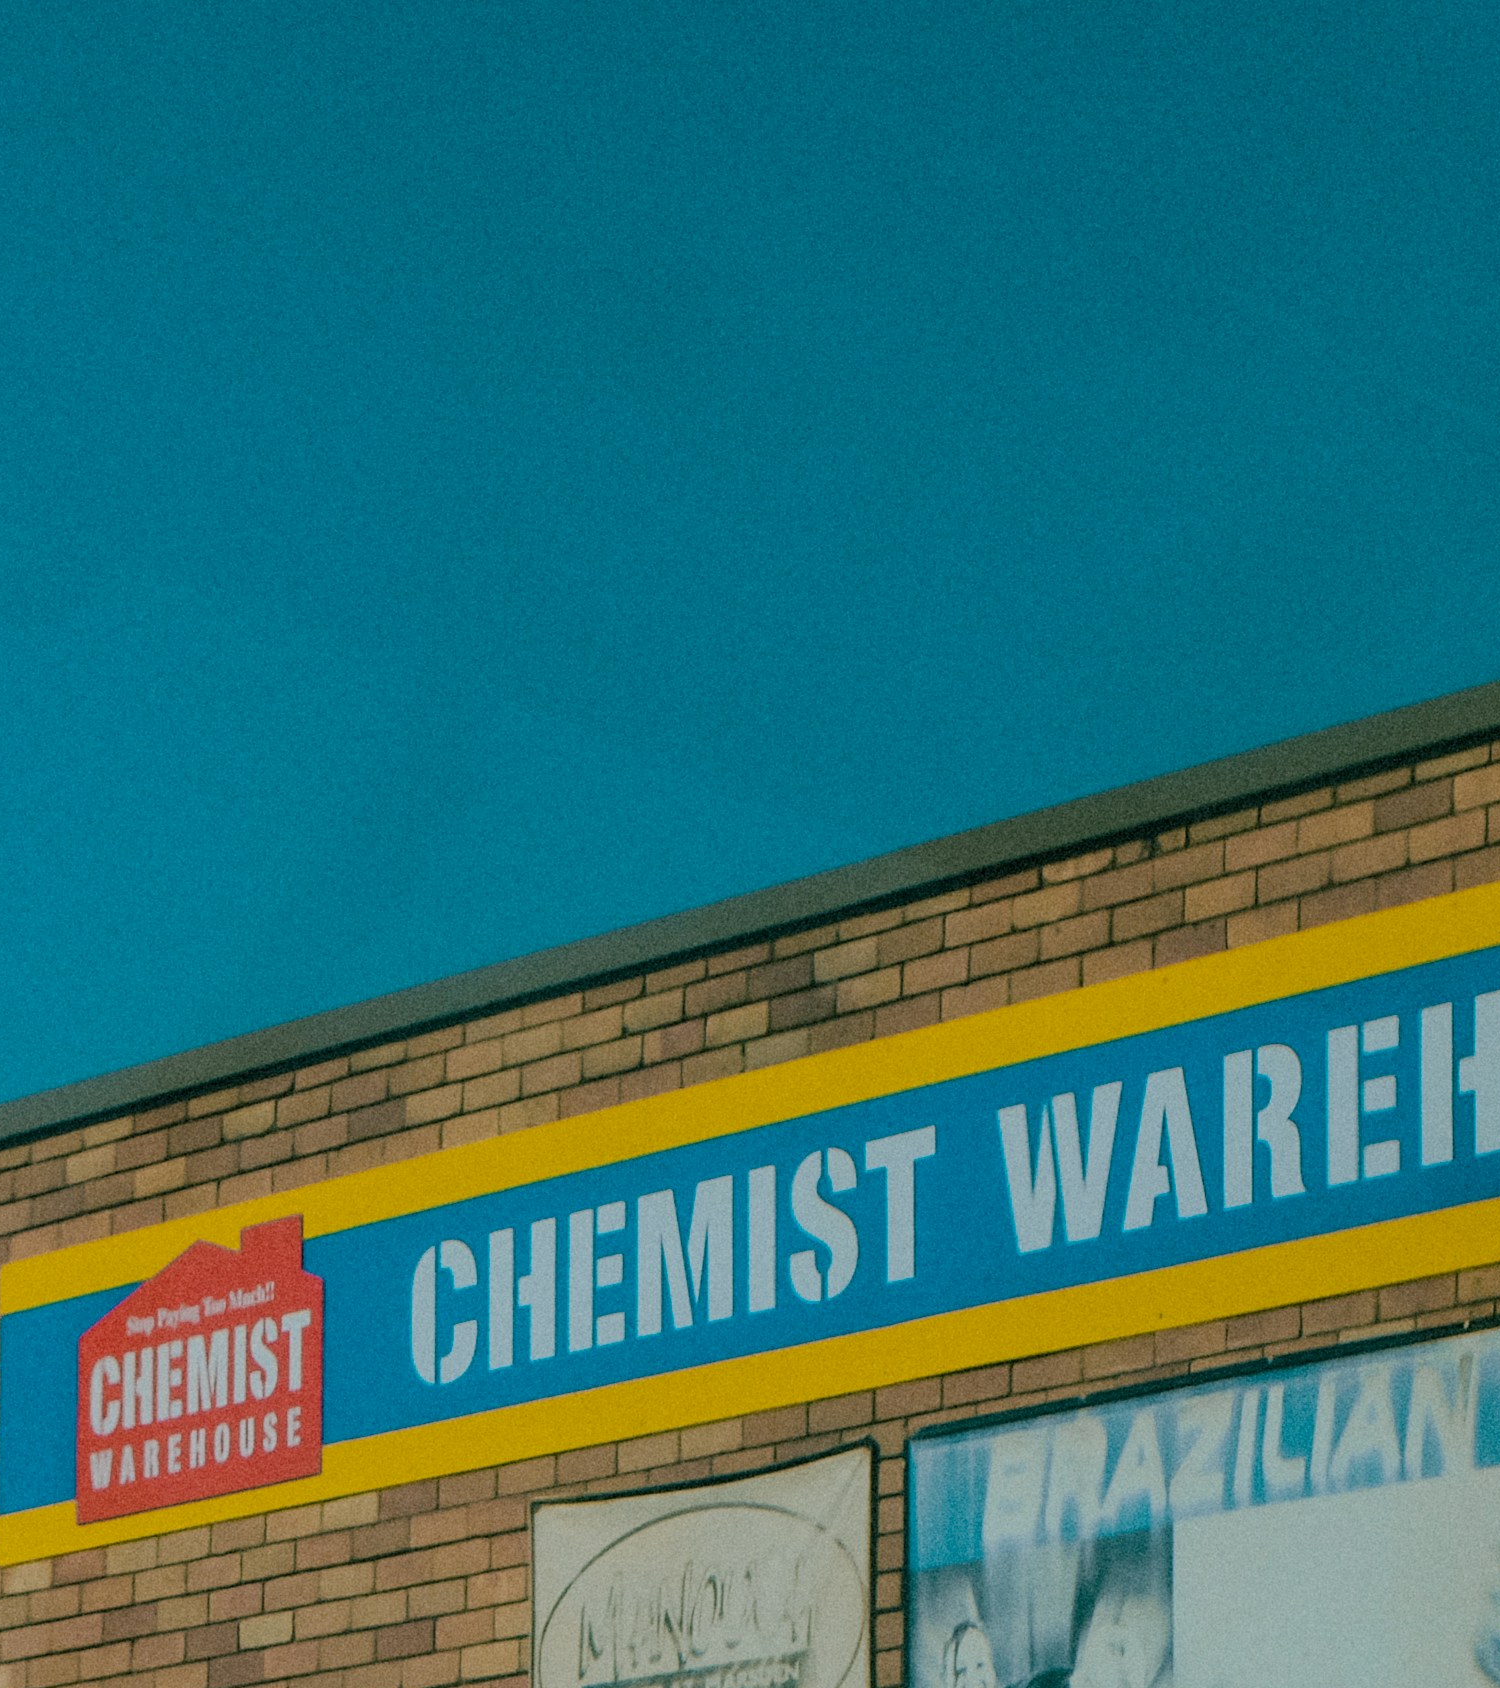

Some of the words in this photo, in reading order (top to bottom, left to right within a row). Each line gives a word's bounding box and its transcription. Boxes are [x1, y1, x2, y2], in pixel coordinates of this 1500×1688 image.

[126, 1315, 155, 1337] Stop
[157, 1304, 200, 1331] Paying
[203, 1296, 227, 1317] Too
[411, 1125, 936, 1387] CHEMIST
[89, 1308, 312, 1437] CHEMIST
[89, 1405, 302, 1492] WAREHOUSE
[983, 1350, 1478, 1542] BRAZILIAN
